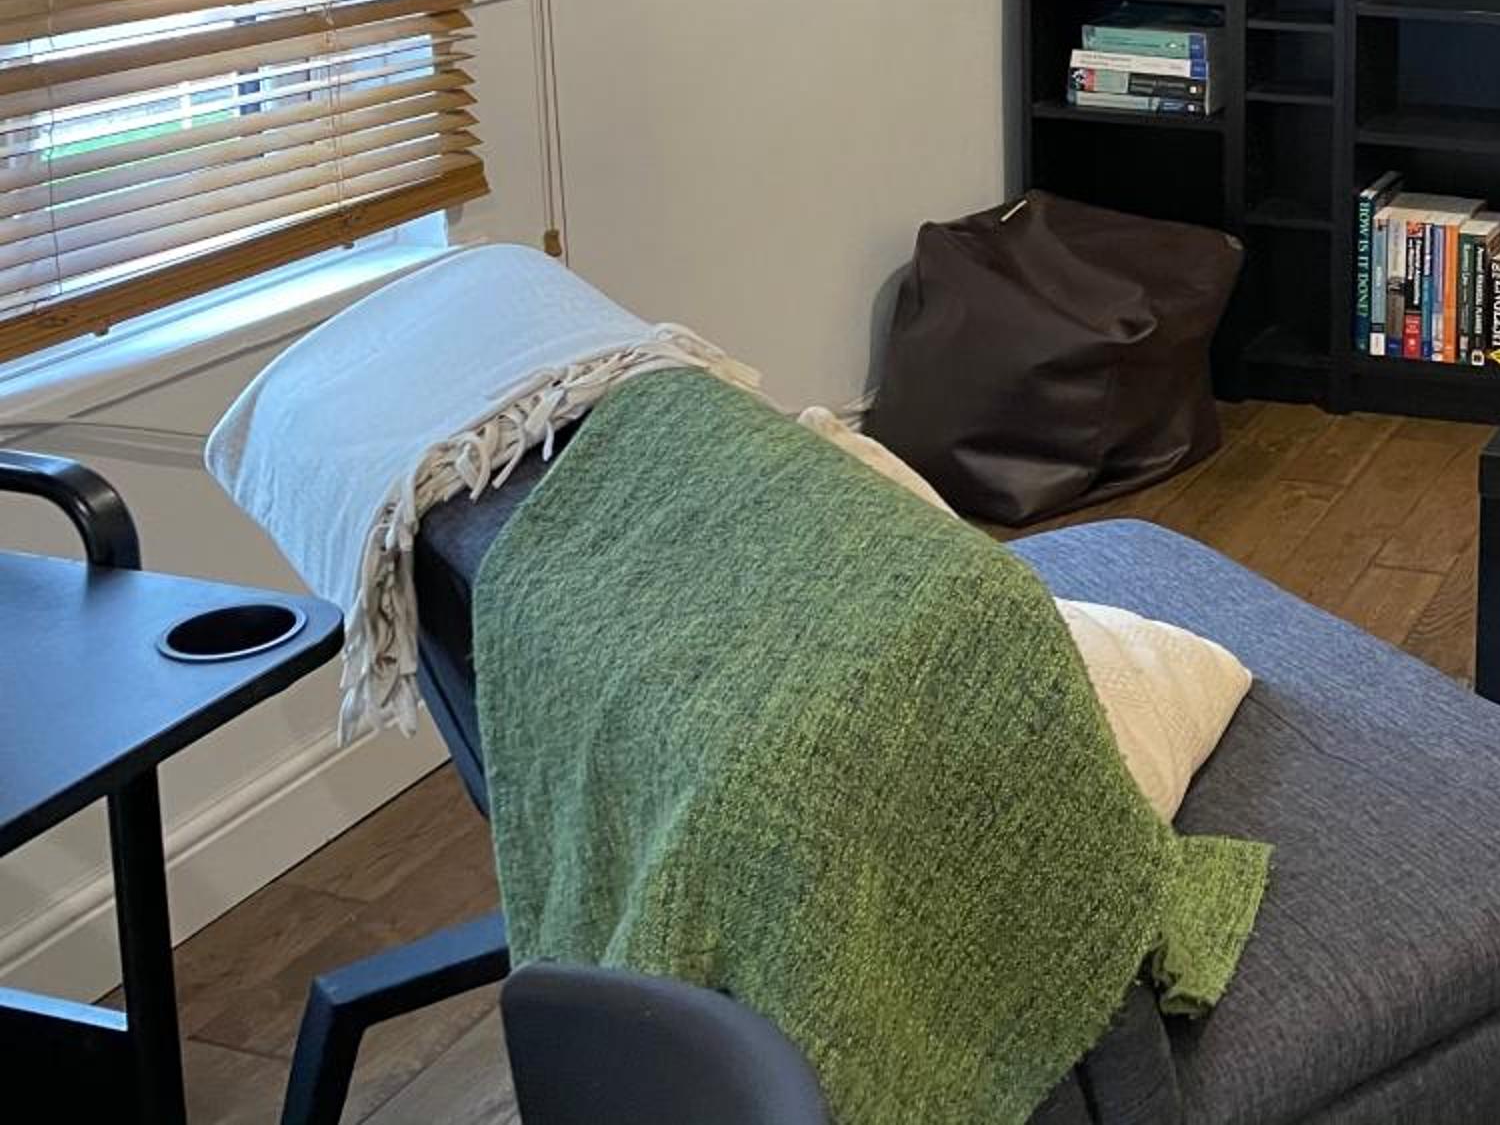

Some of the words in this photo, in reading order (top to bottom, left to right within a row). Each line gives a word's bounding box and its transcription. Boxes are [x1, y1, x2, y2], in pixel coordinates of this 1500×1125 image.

[1359, 201, 1371, 237] HOW
[1358, 240, 1370, 252] IS
[1358, 255, 1369, 270] IT
